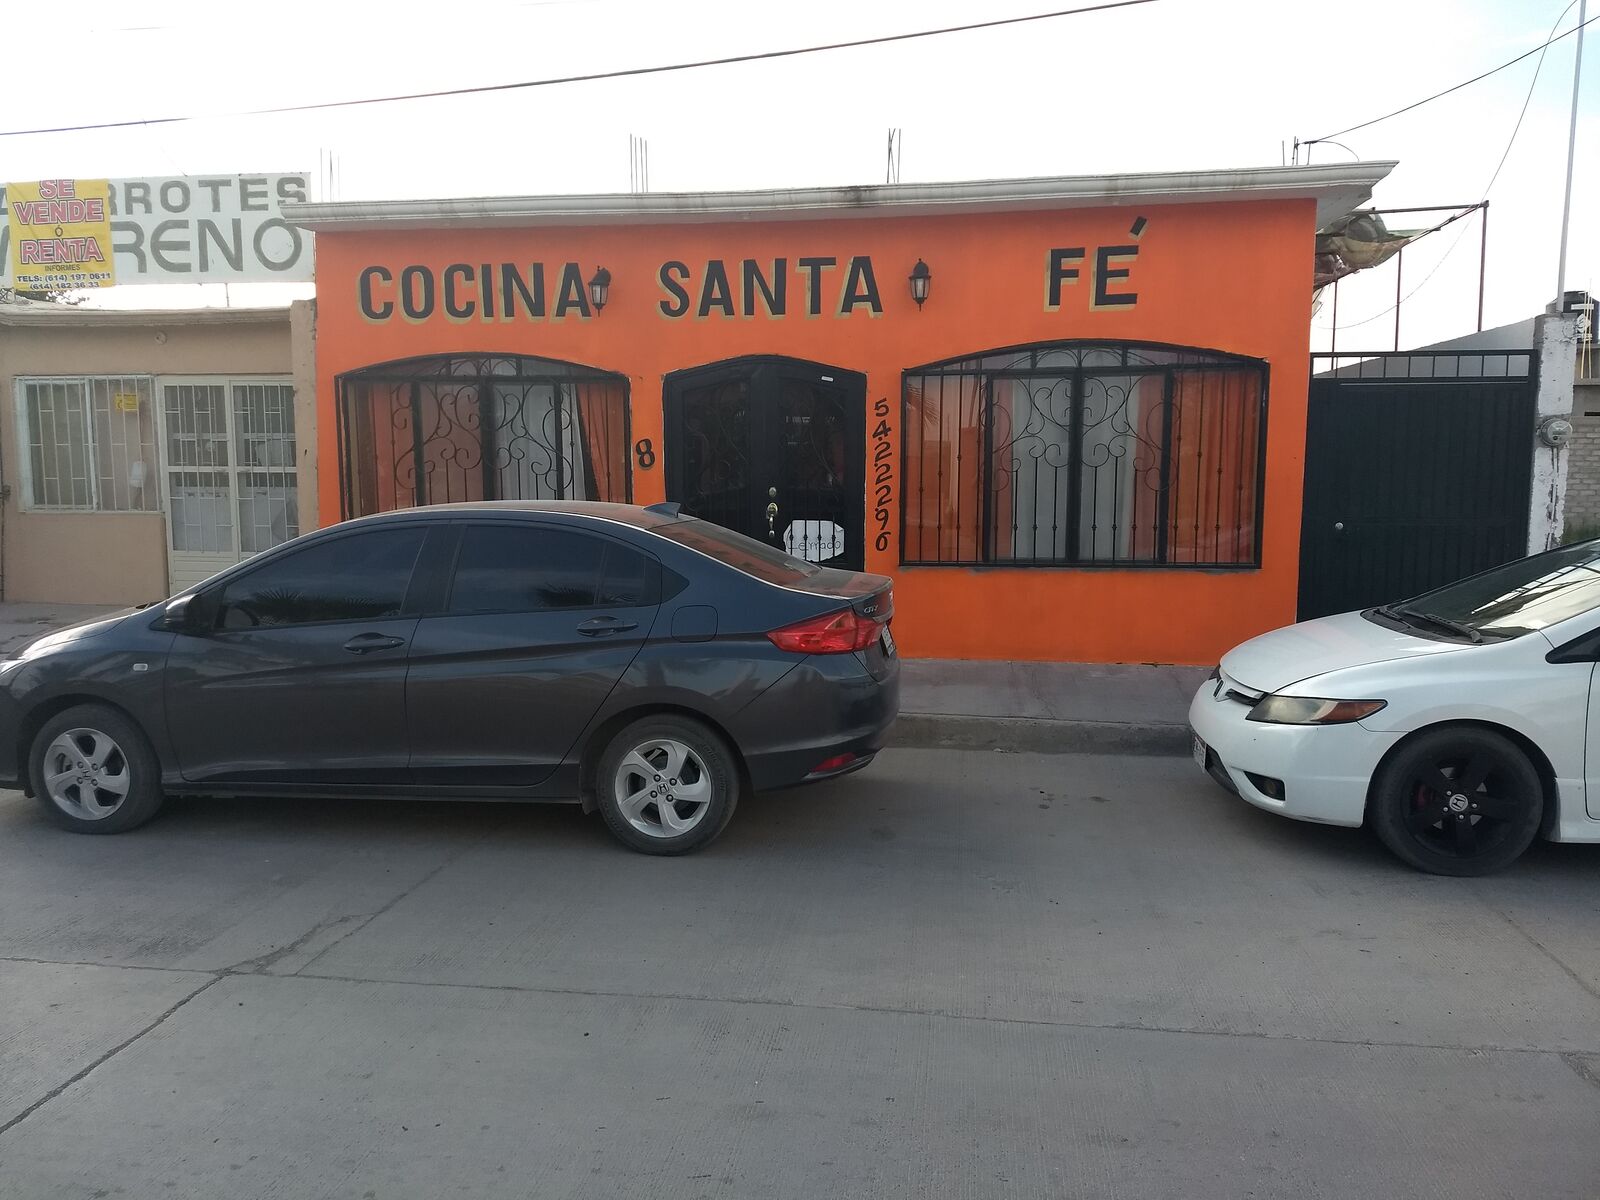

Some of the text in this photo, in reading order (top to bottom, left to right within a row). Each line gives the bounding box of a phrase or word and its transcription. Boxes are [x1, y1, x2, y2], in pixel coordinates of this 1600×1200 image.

[39, 179, 76, 199] SE
[13, 198, 104, 225] VENDE
[20, 236, 105, 264] RENTA
[17, 275, 43, 283] TELS:
[45, 274, 67, 282] (614)
[70, 273, 87, 281] 197
[45, 264, 80, 272] INFORMES
[357, 215, 1148, 323] COCINA SANTA FÉ
[89, 280, 100, 288] 33
[635, 438, 656, 468] 8
